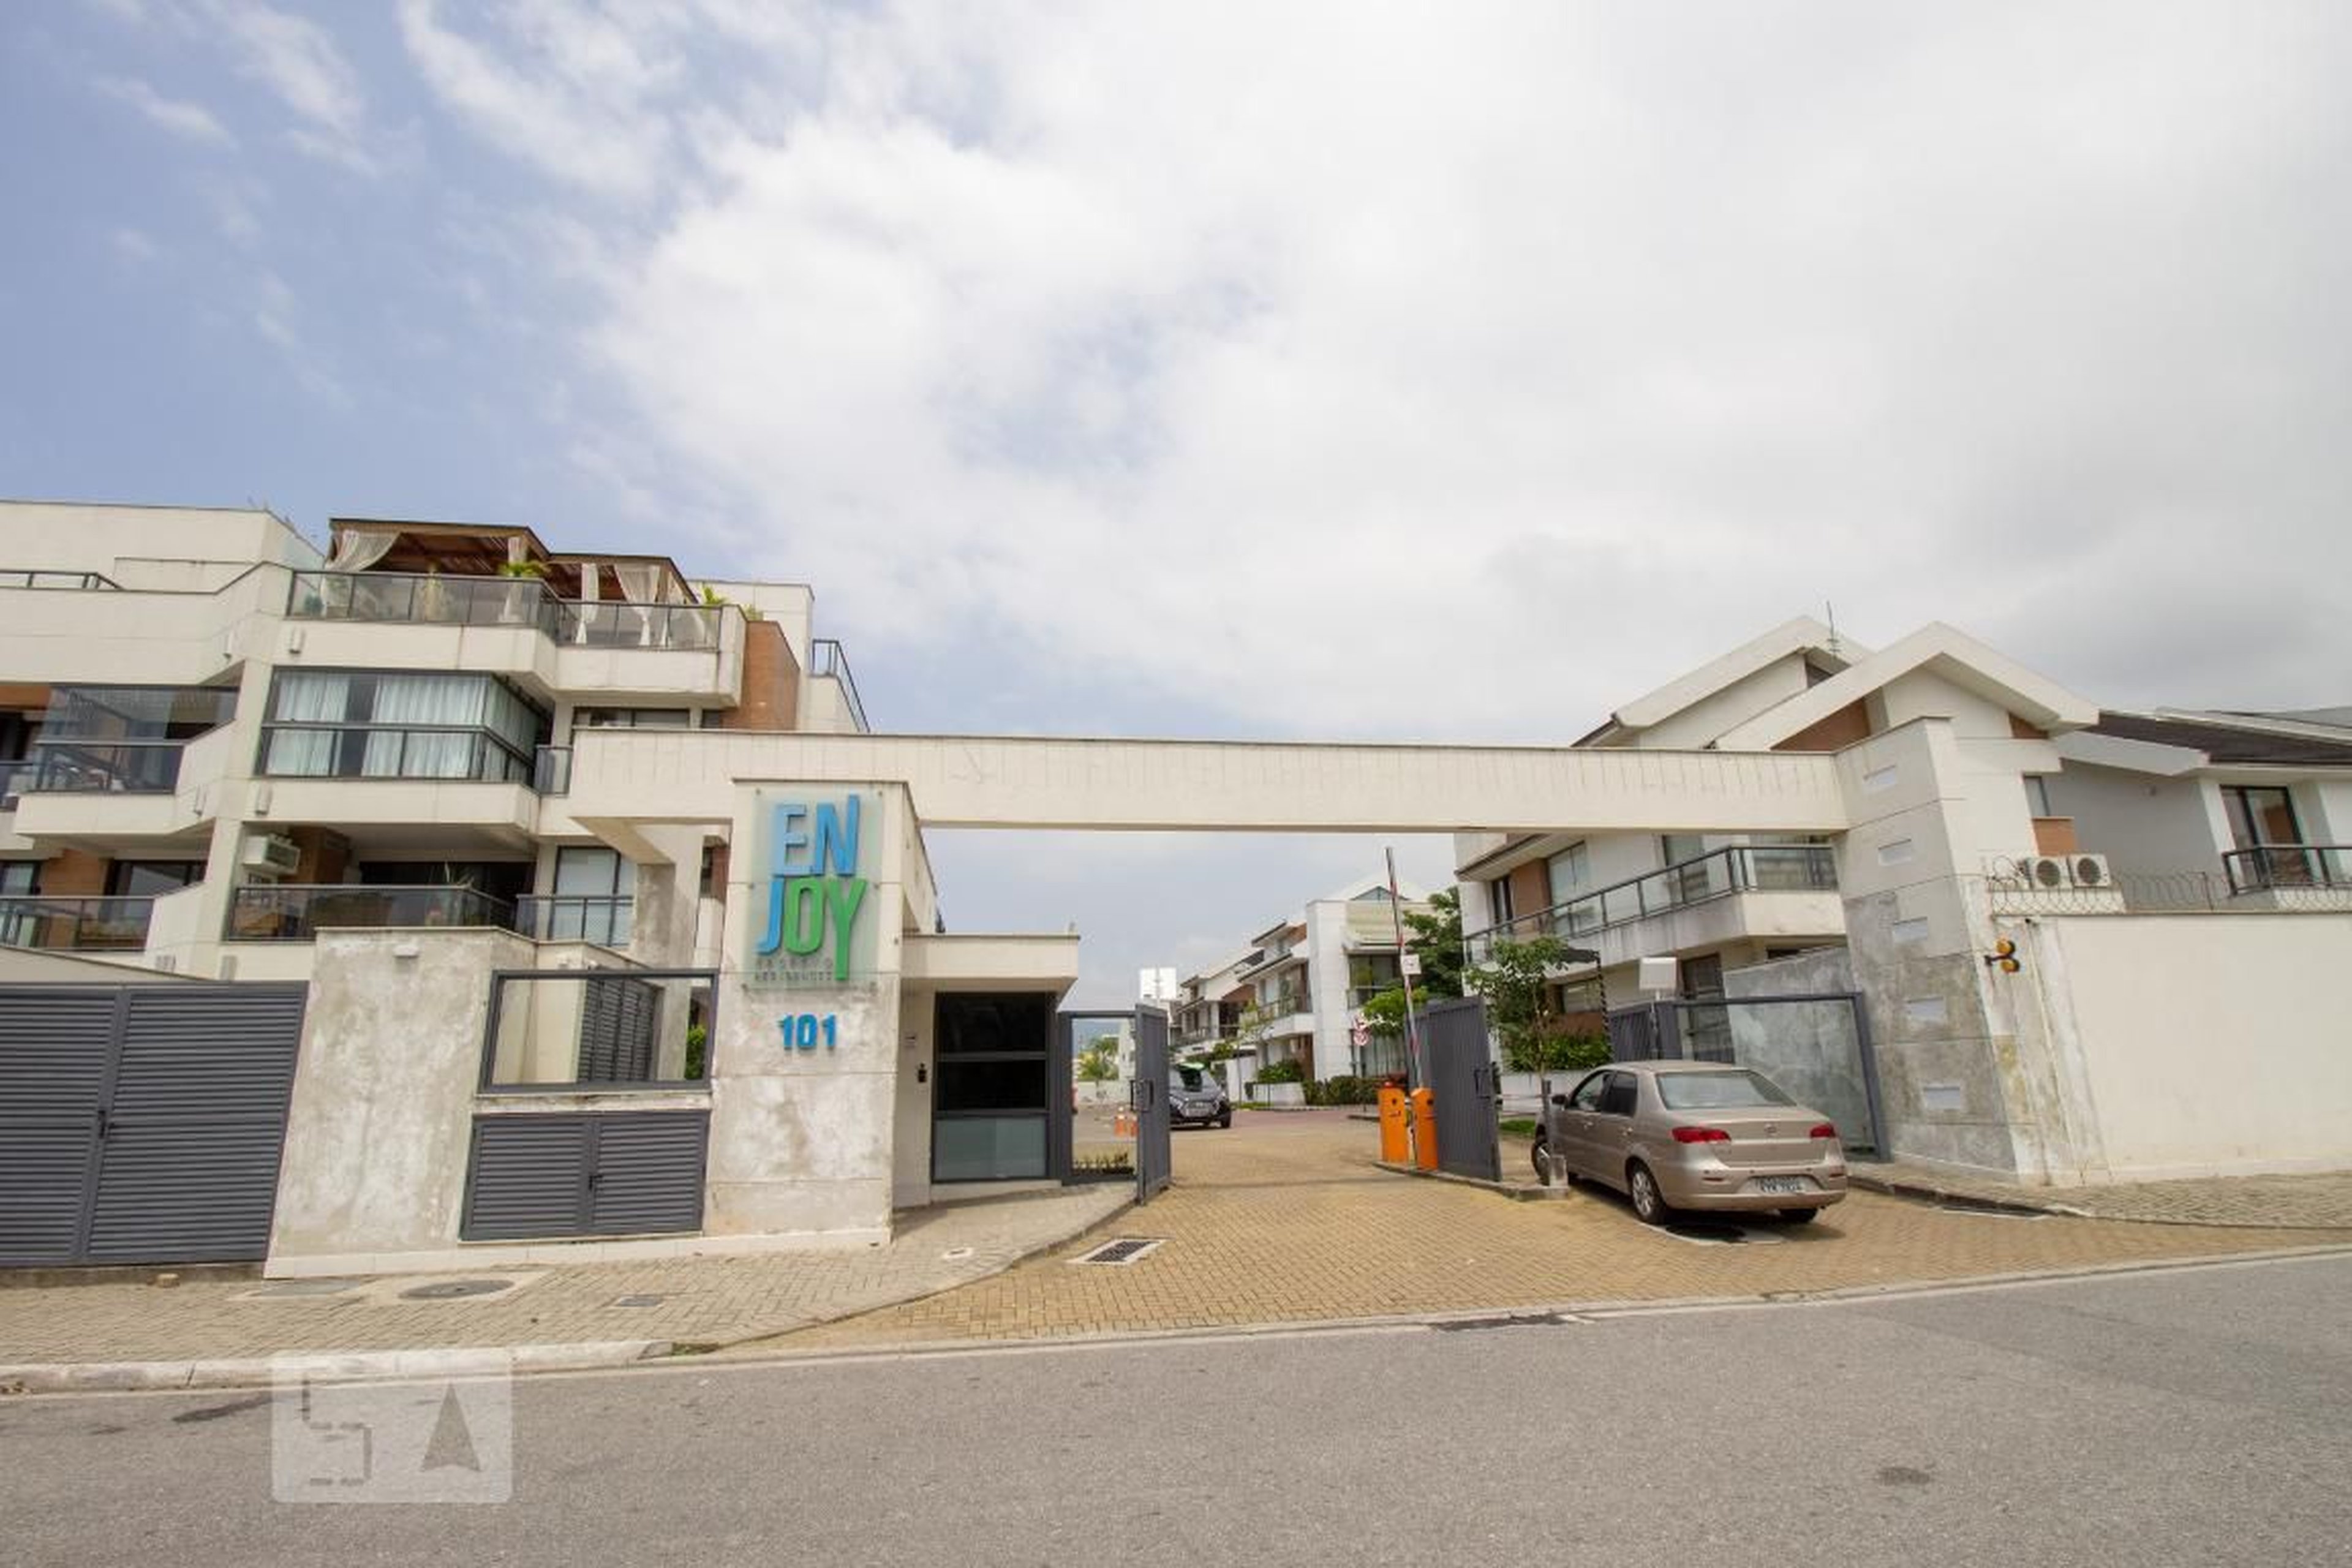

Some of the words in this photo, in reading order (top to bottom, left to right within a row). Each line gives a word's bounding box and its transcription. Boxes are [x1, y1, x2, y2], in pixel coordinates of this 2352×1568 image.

[772, 794, 860, 877] EN
[755, 877, 867, 981] JOY
[777, 1013, 837, 1048] 101
